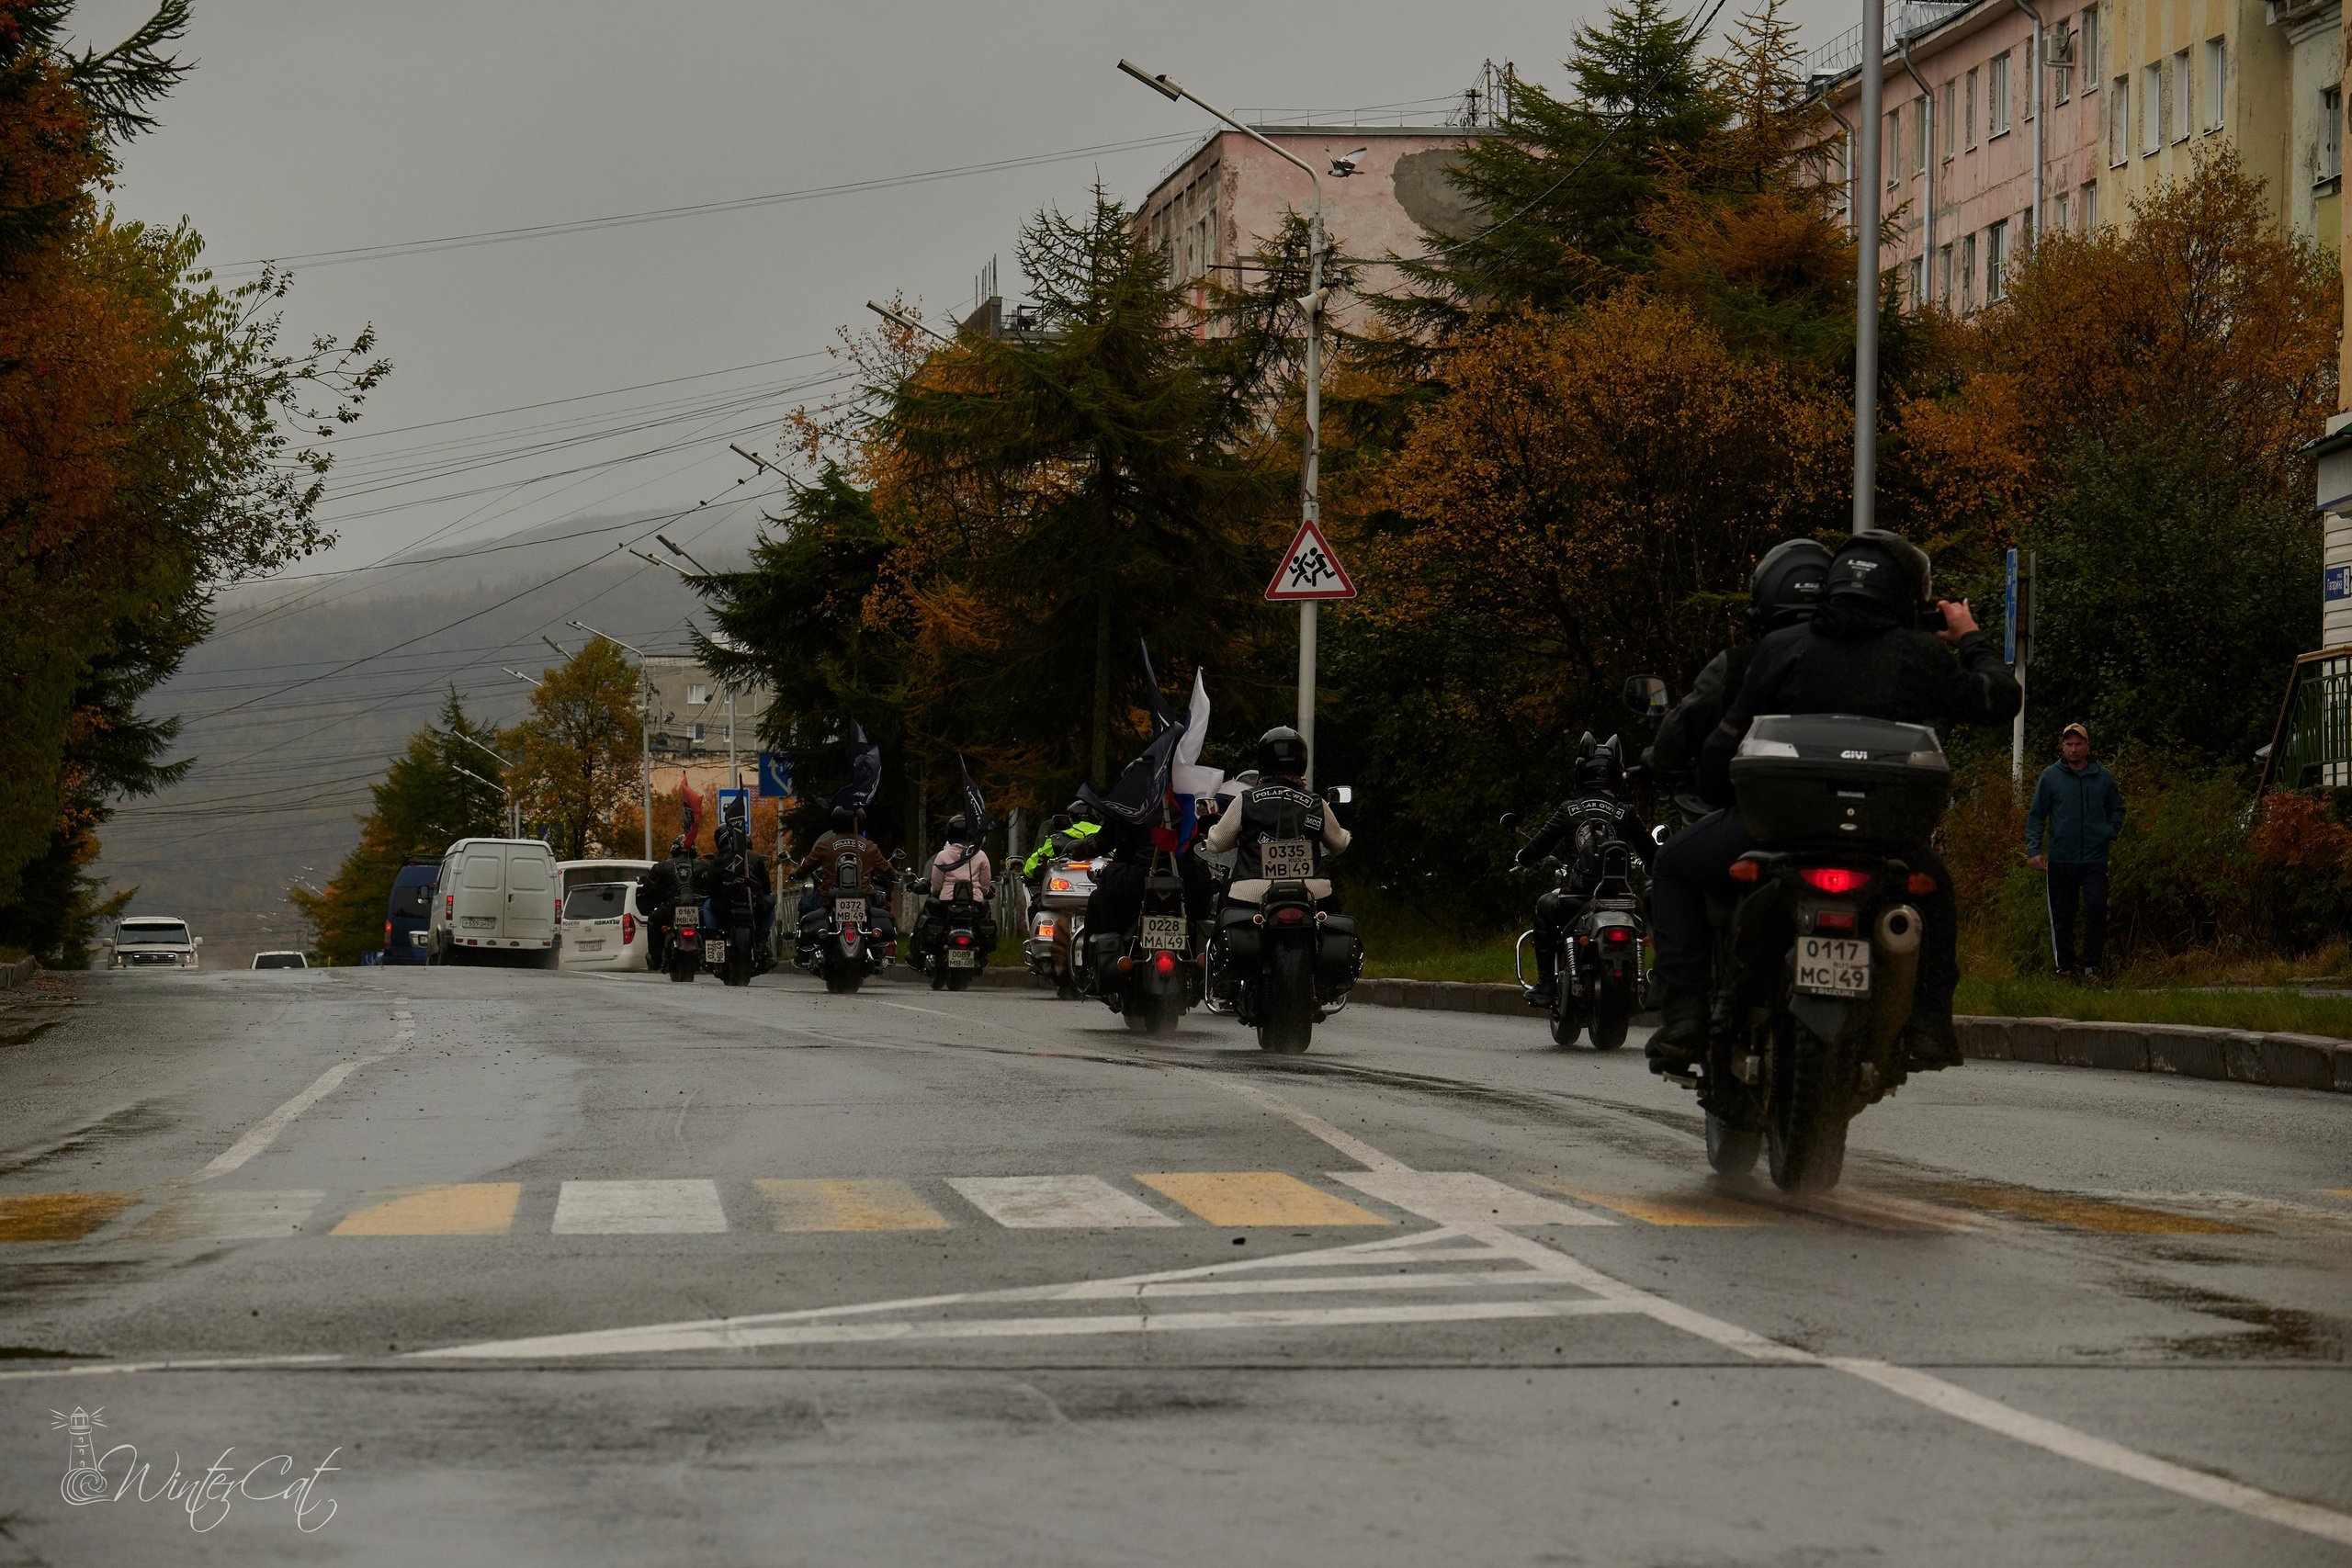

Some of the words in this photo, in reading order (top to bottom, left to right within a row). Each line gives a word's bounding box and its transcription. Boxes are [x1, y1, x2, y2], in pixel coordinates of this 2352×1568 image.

[1840, 750, 1868, 760] GIVI
[1255, 790, 1283, 799] POLAR
[1305, 817, 1321, 827] MCC
[1269, 845, 1305, 858] 0335
[1264, 863, 1287, 876] MB
[1293, 863, 1310, 875] 49
[840, 901, 862, 909] 0372
[837, 911, 851, 920] MB
[853, 911, 864, 920] 49
[1148, 919, 1180, 931] 0228
[717, 942, 724, 950] 49
[1144, 936, 1163, 948] MA
[1168, 937, 1183, 948] 49
[707, 943, 715, 960] 0337
[1806, 940, 1859, 961] 0117
[1801, 966, 1829, 985] MC
[1839, 969, 1864, 987] 49
[1818, 987, 1855, 997] SUZUKI
